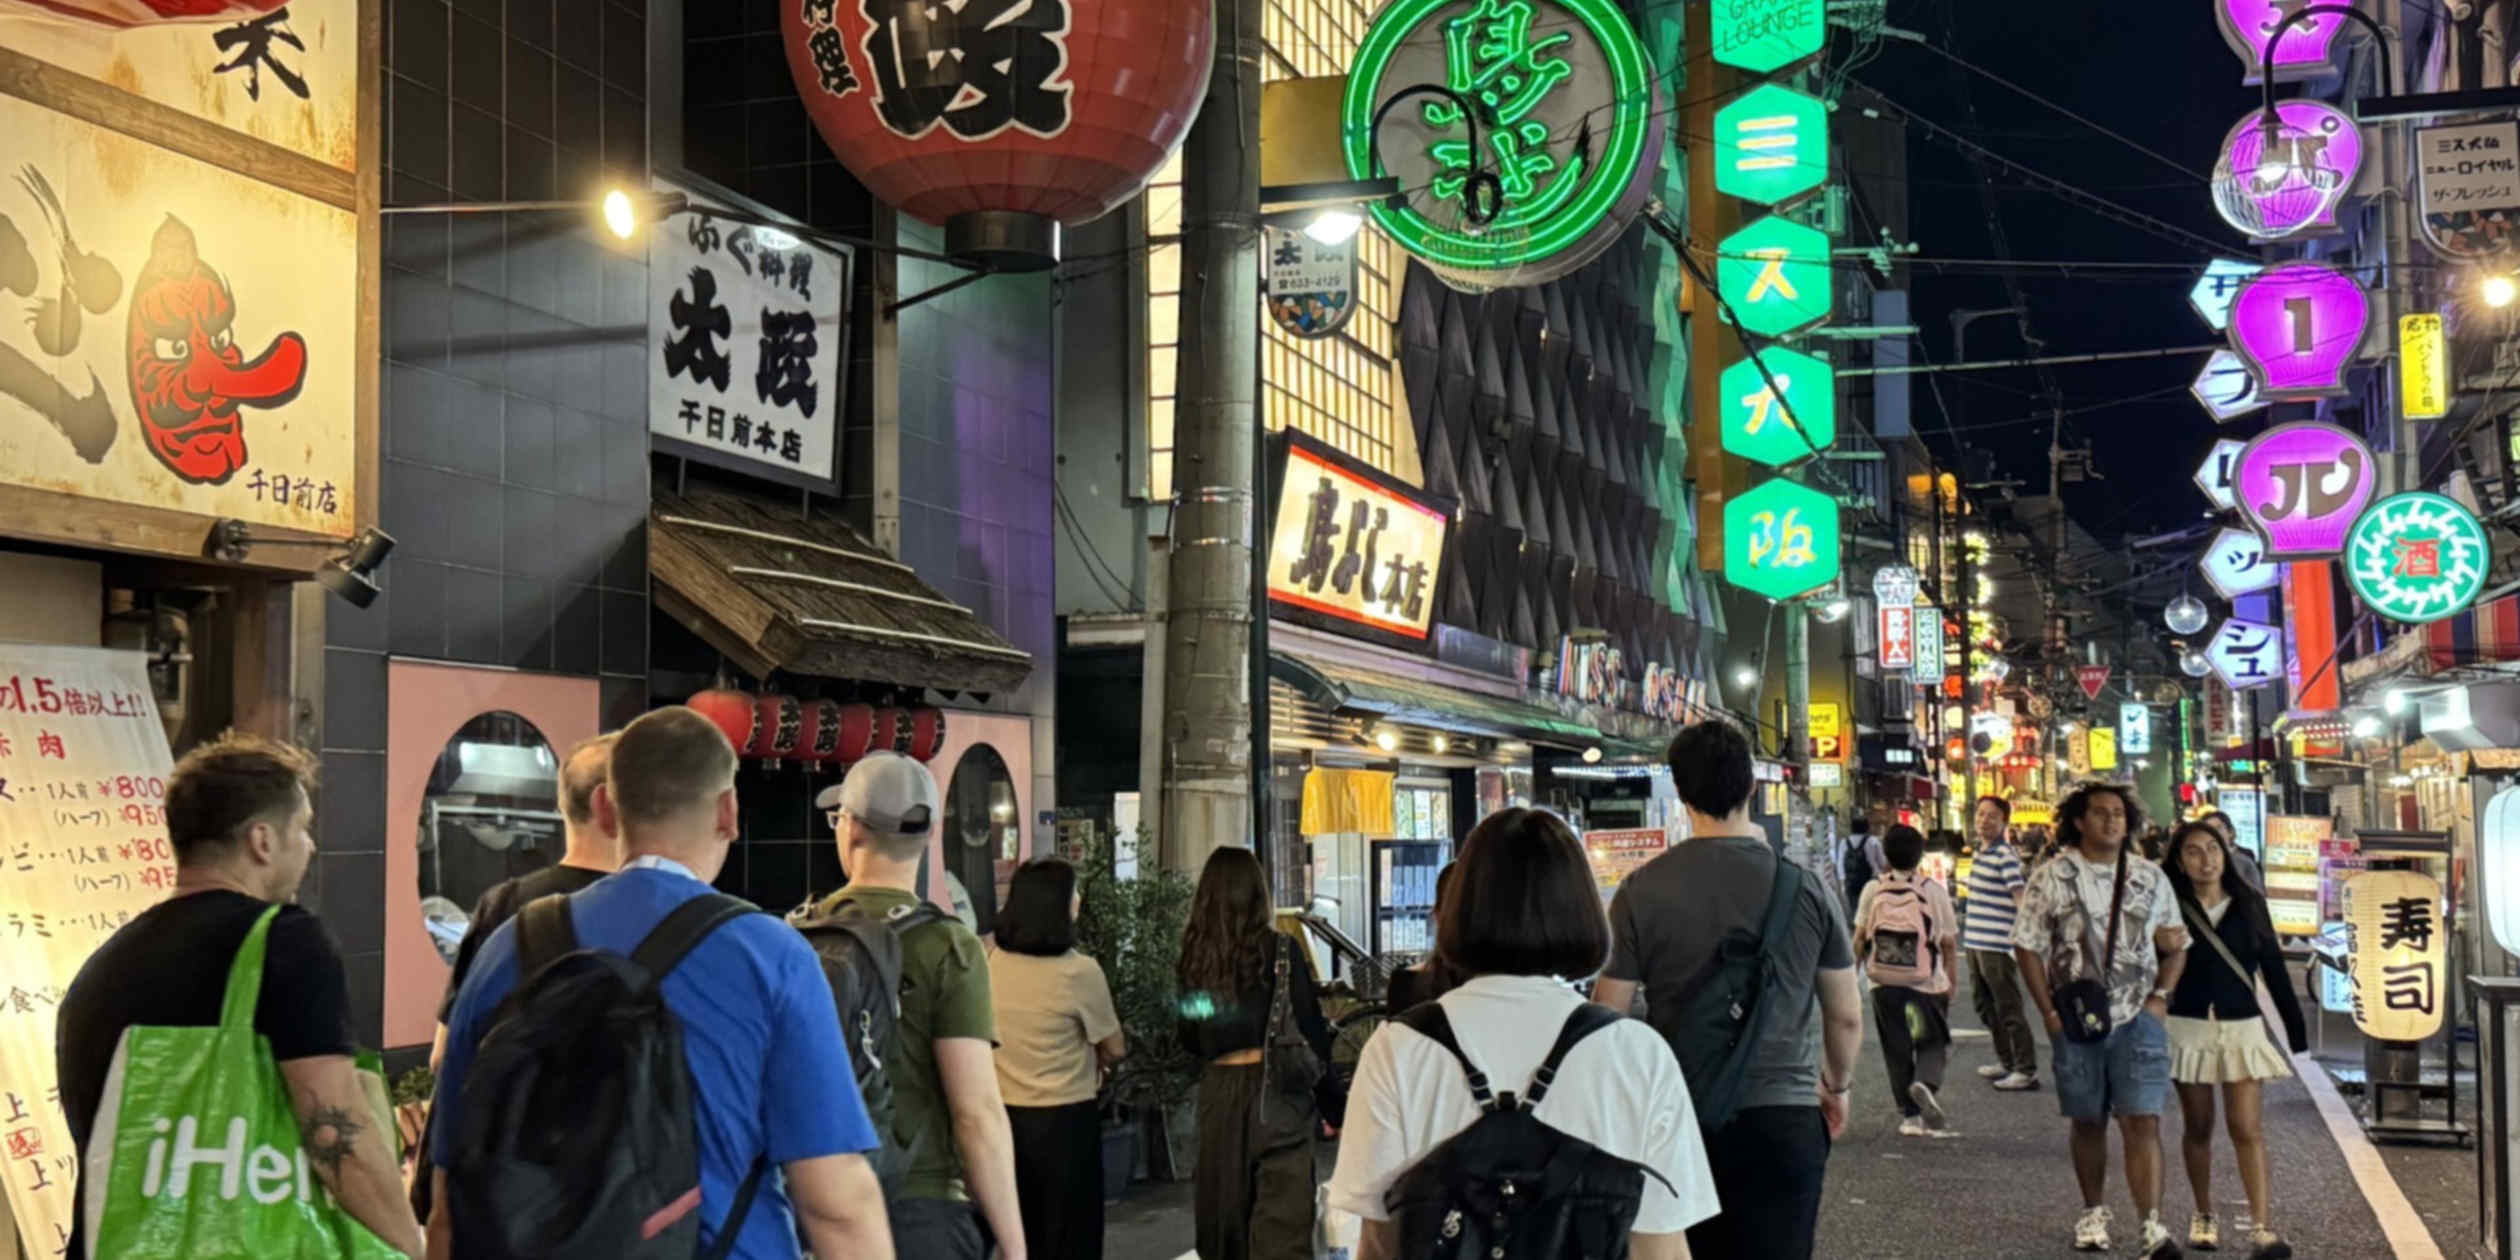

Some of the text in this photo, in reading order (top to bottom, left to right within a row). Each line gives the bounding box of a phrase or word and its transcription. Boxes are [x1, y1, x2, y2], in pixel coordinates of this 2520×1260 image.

[1722, 1, 1814, 52] LOUNGE
[687, 212, 813, 302] ふぐ料理
[678, 399, 803, 464] 千日前本店
[246, 469, 338, 515] 千日前店
[2393, 536, 2440, 578] 酒
[1818, 736, 1838, 758] P
[2380, 896, 2434, 1016] 寿司
